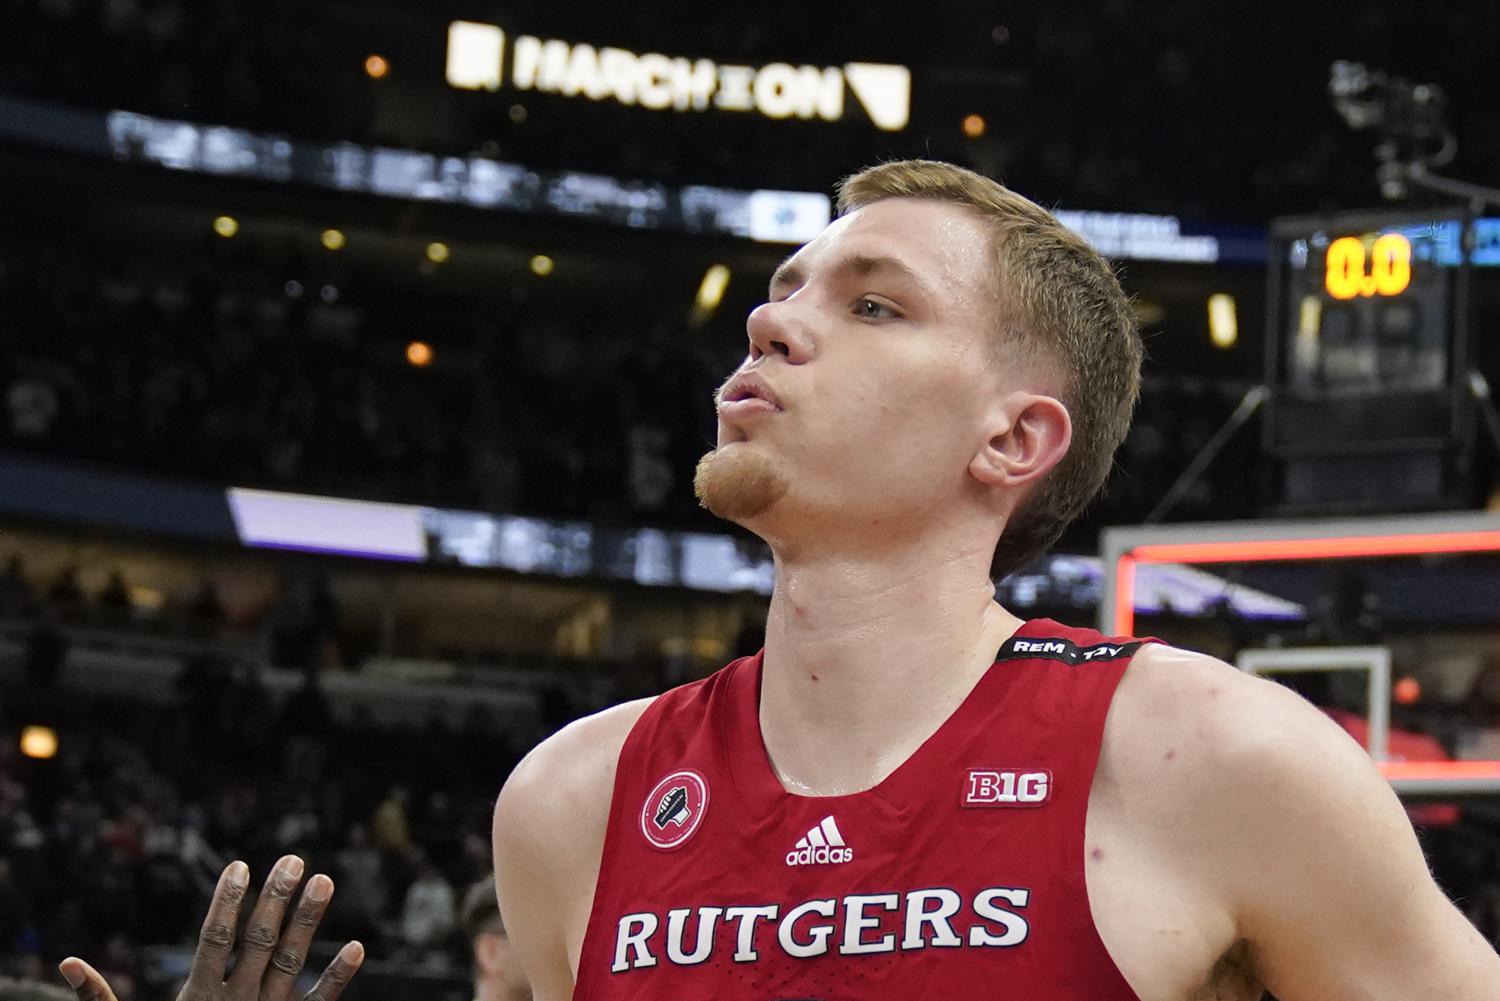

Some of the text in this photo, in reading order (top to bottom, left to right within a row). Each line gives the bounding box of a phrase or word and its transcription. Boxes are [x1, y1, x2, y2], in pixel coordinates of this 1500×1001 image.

[1326, 234, 1412, 299] 0.0
[785, 842, 854, 867] adidas
[610, 887, 1031, 974] RUTGERS
